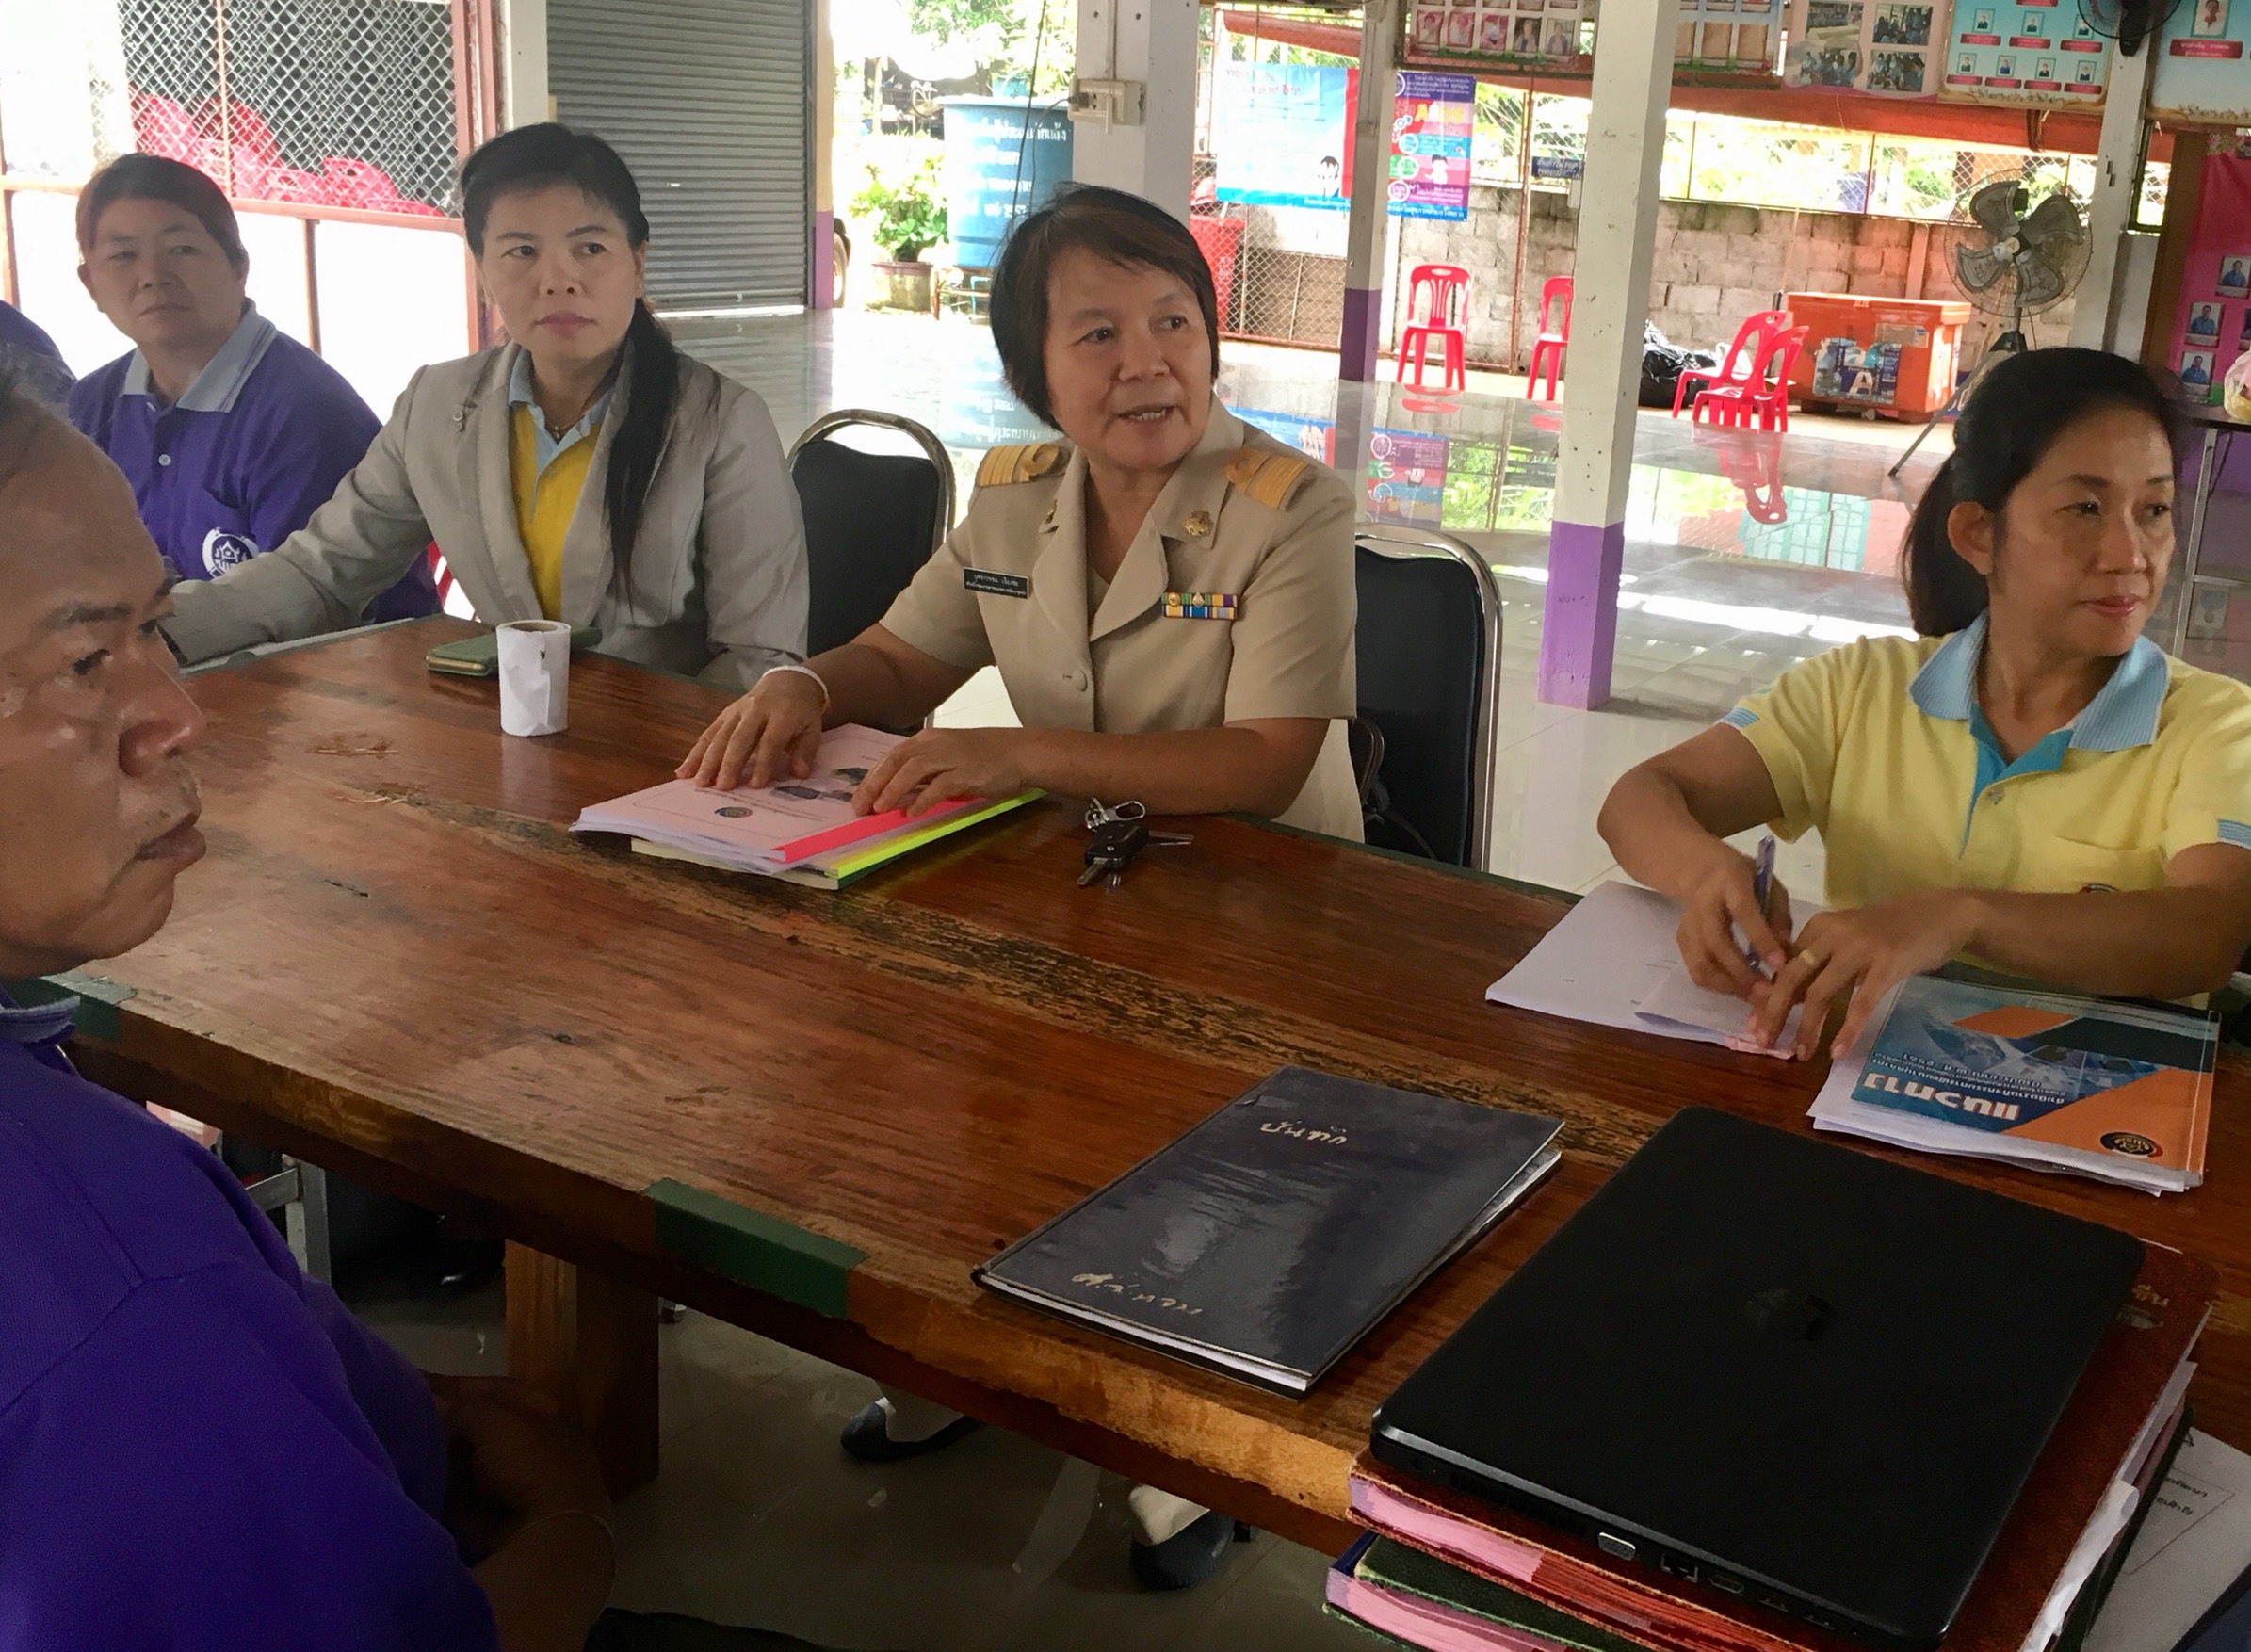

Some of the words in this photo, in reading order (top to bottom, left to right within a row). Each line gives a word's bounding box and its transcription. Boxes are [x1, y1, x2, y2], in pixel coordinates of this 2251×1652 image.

[1414, 103, 1465, 123] ADS
[1861, 1071, 2020, 1122] แนวทาง
